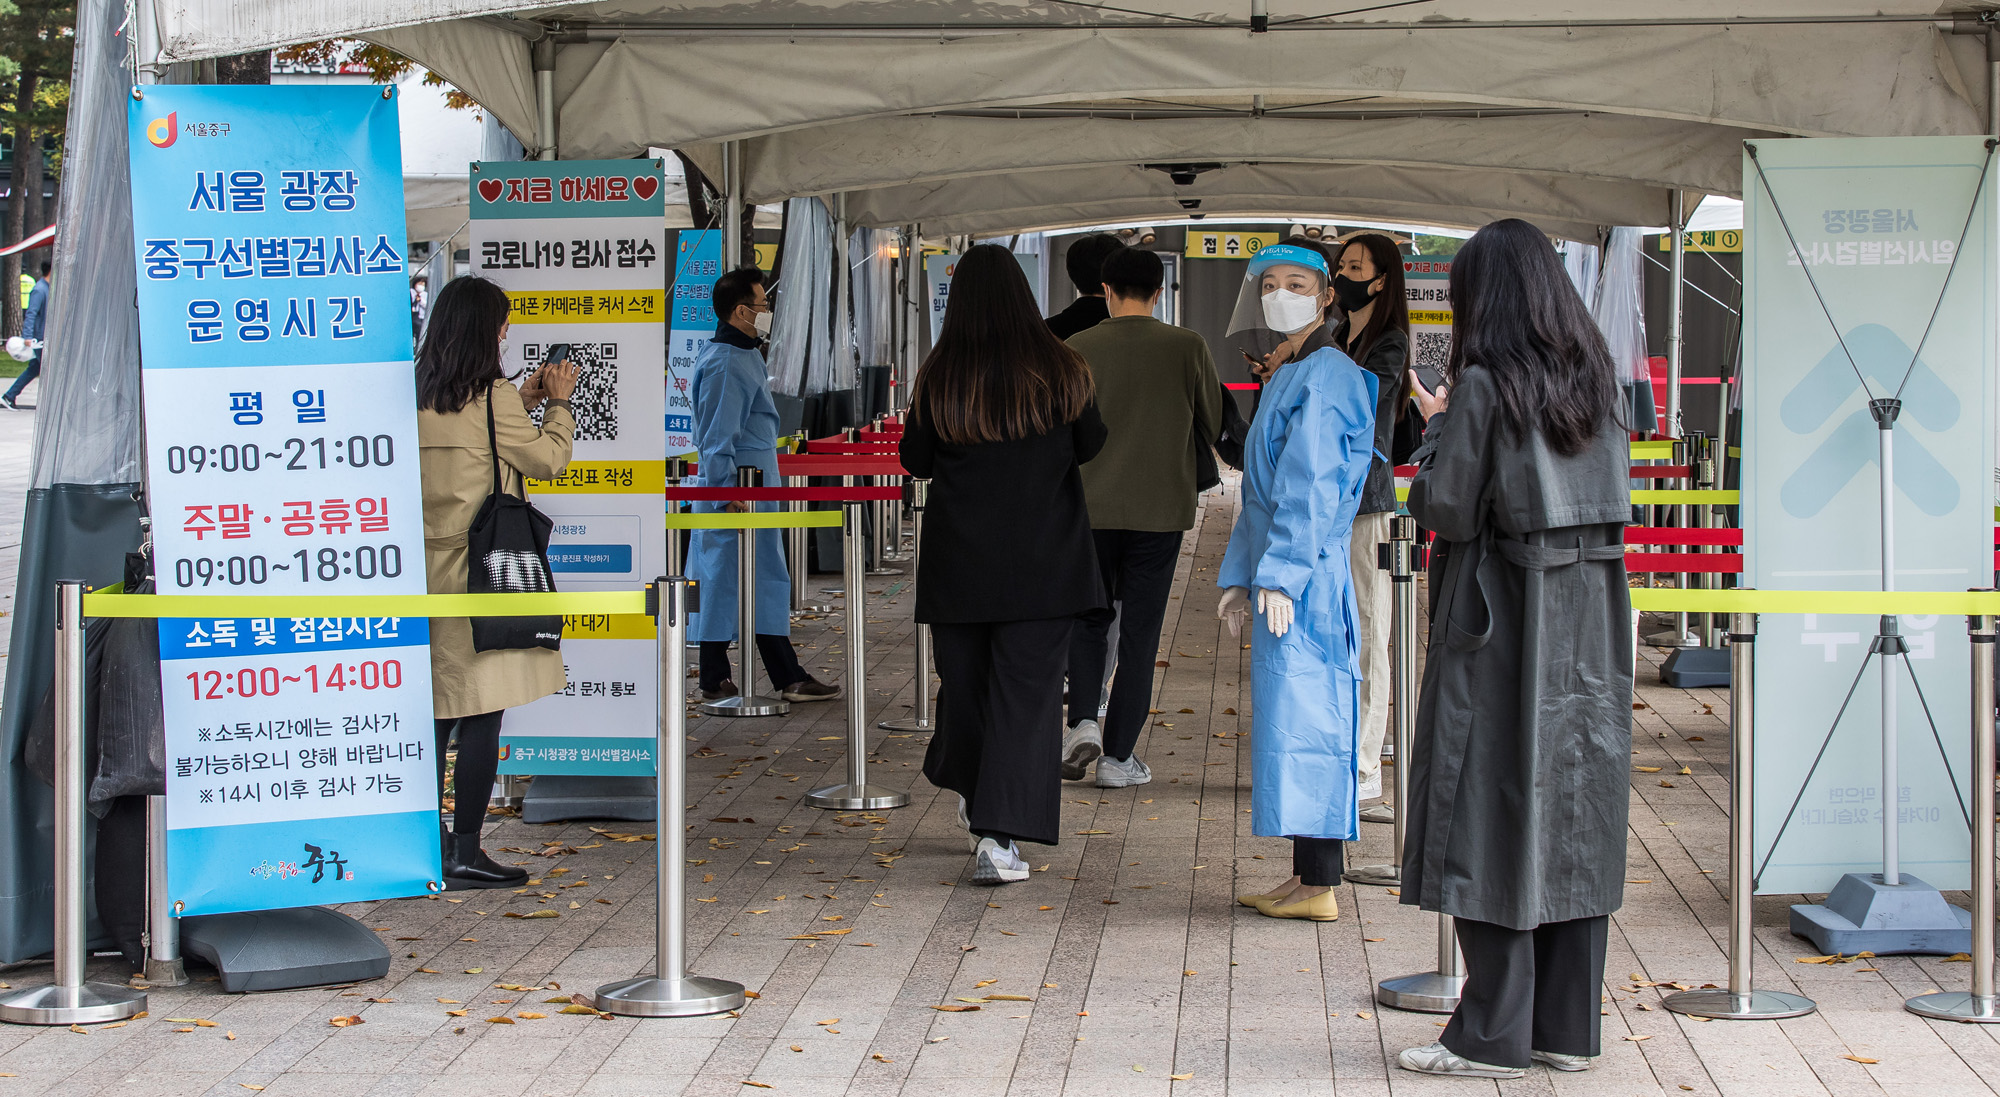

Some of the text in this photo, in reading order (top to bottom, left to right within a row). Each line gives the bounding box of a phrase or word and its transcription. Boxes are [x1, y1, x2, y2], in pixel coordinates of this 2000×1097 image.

[185, 122, 231, 137] 서울중구
[188, 169, 359, 212] 서울 광장
[506, 175, 630, 203] 지금 하세요
[143, 234, 403, 280] 중구선별검사소
[481, 238, 656, 269] 코로나19 검사 접수
[702, 260, 717, 276] 광장
[542, 296, 595, 315] 카메라를
[598, 296, 624, 314] 켜서
[627, 295, 654, 314] 스캔
[186, 296, 367, 343] 운영시간
[167, 434, 395, 474] 09:00~21:00
[525, 468, 633, 487] 문진표 작성
[553, 525, 586, 535] 시청광장
[175, 544, 402, 588] 09:00~18:00
[562, 554, 581, 563] 문진표
[583, 554, 610, 563] 작성하기
[185, 617, 401, 648] 소독 및 점심시간
[581, 614, 610, 632] 대기
[186, 659, 402, 701] 12:00~14:00
[554, 681, 637, 697] 전 문자 통보
[342, 712, 400, 735] 검사가
[175, 740, 424, 778] 불가능하오니 양해 바랍니다
[514, 747, 651, 762] 중구 시청광장 임시선별검사소
[270, 779, 309, 801] 이후
[318, 775, 356, 798] 검사
[365, 773, 404, 794] 가능
[302, 843, 348, 884] 중구
